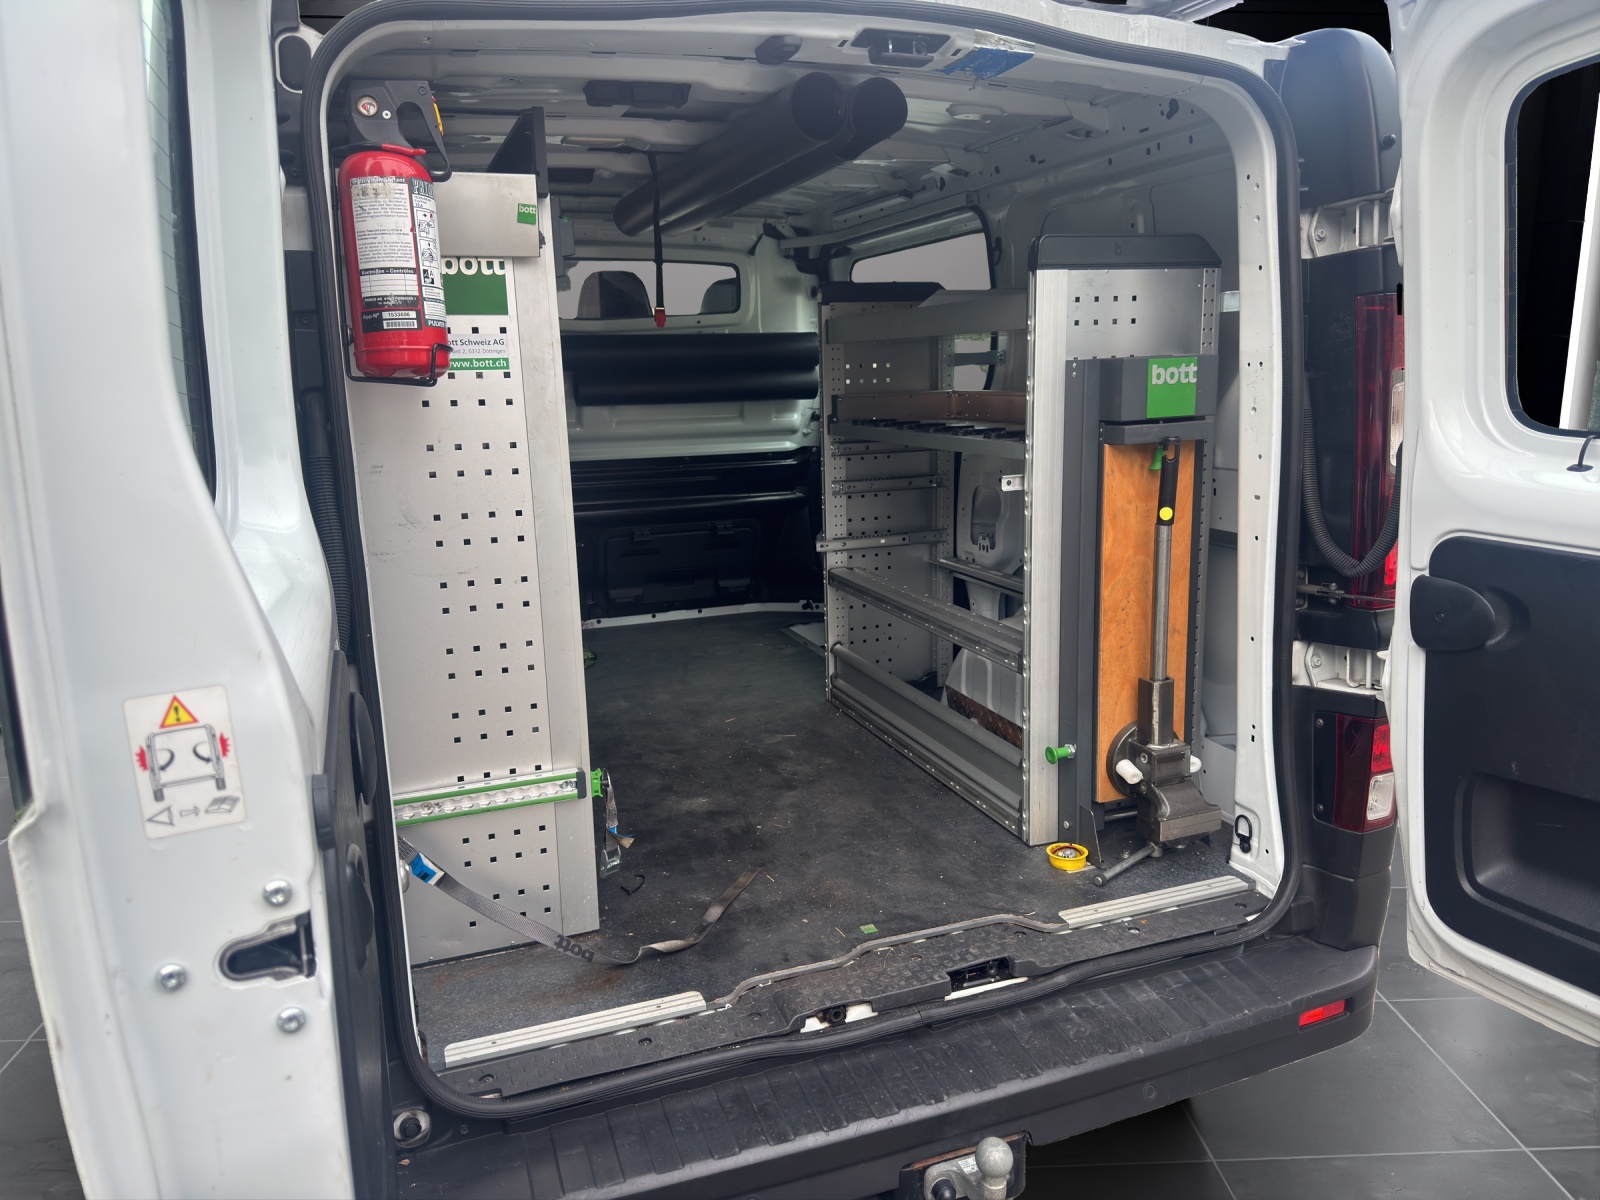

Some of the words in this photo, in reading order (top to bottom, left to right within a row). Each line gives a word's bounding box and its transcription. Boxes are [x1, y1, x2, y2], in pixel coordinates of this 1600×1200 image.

[518, 204, 537, 215] bott
[441, 256, 506, 276] bott
[459, 338, 491, 346] Schweiz
[492, 338, 505, 346] AG
[1151, 362, 1198, 385] bott
[554, 934, 595, 962] bott
